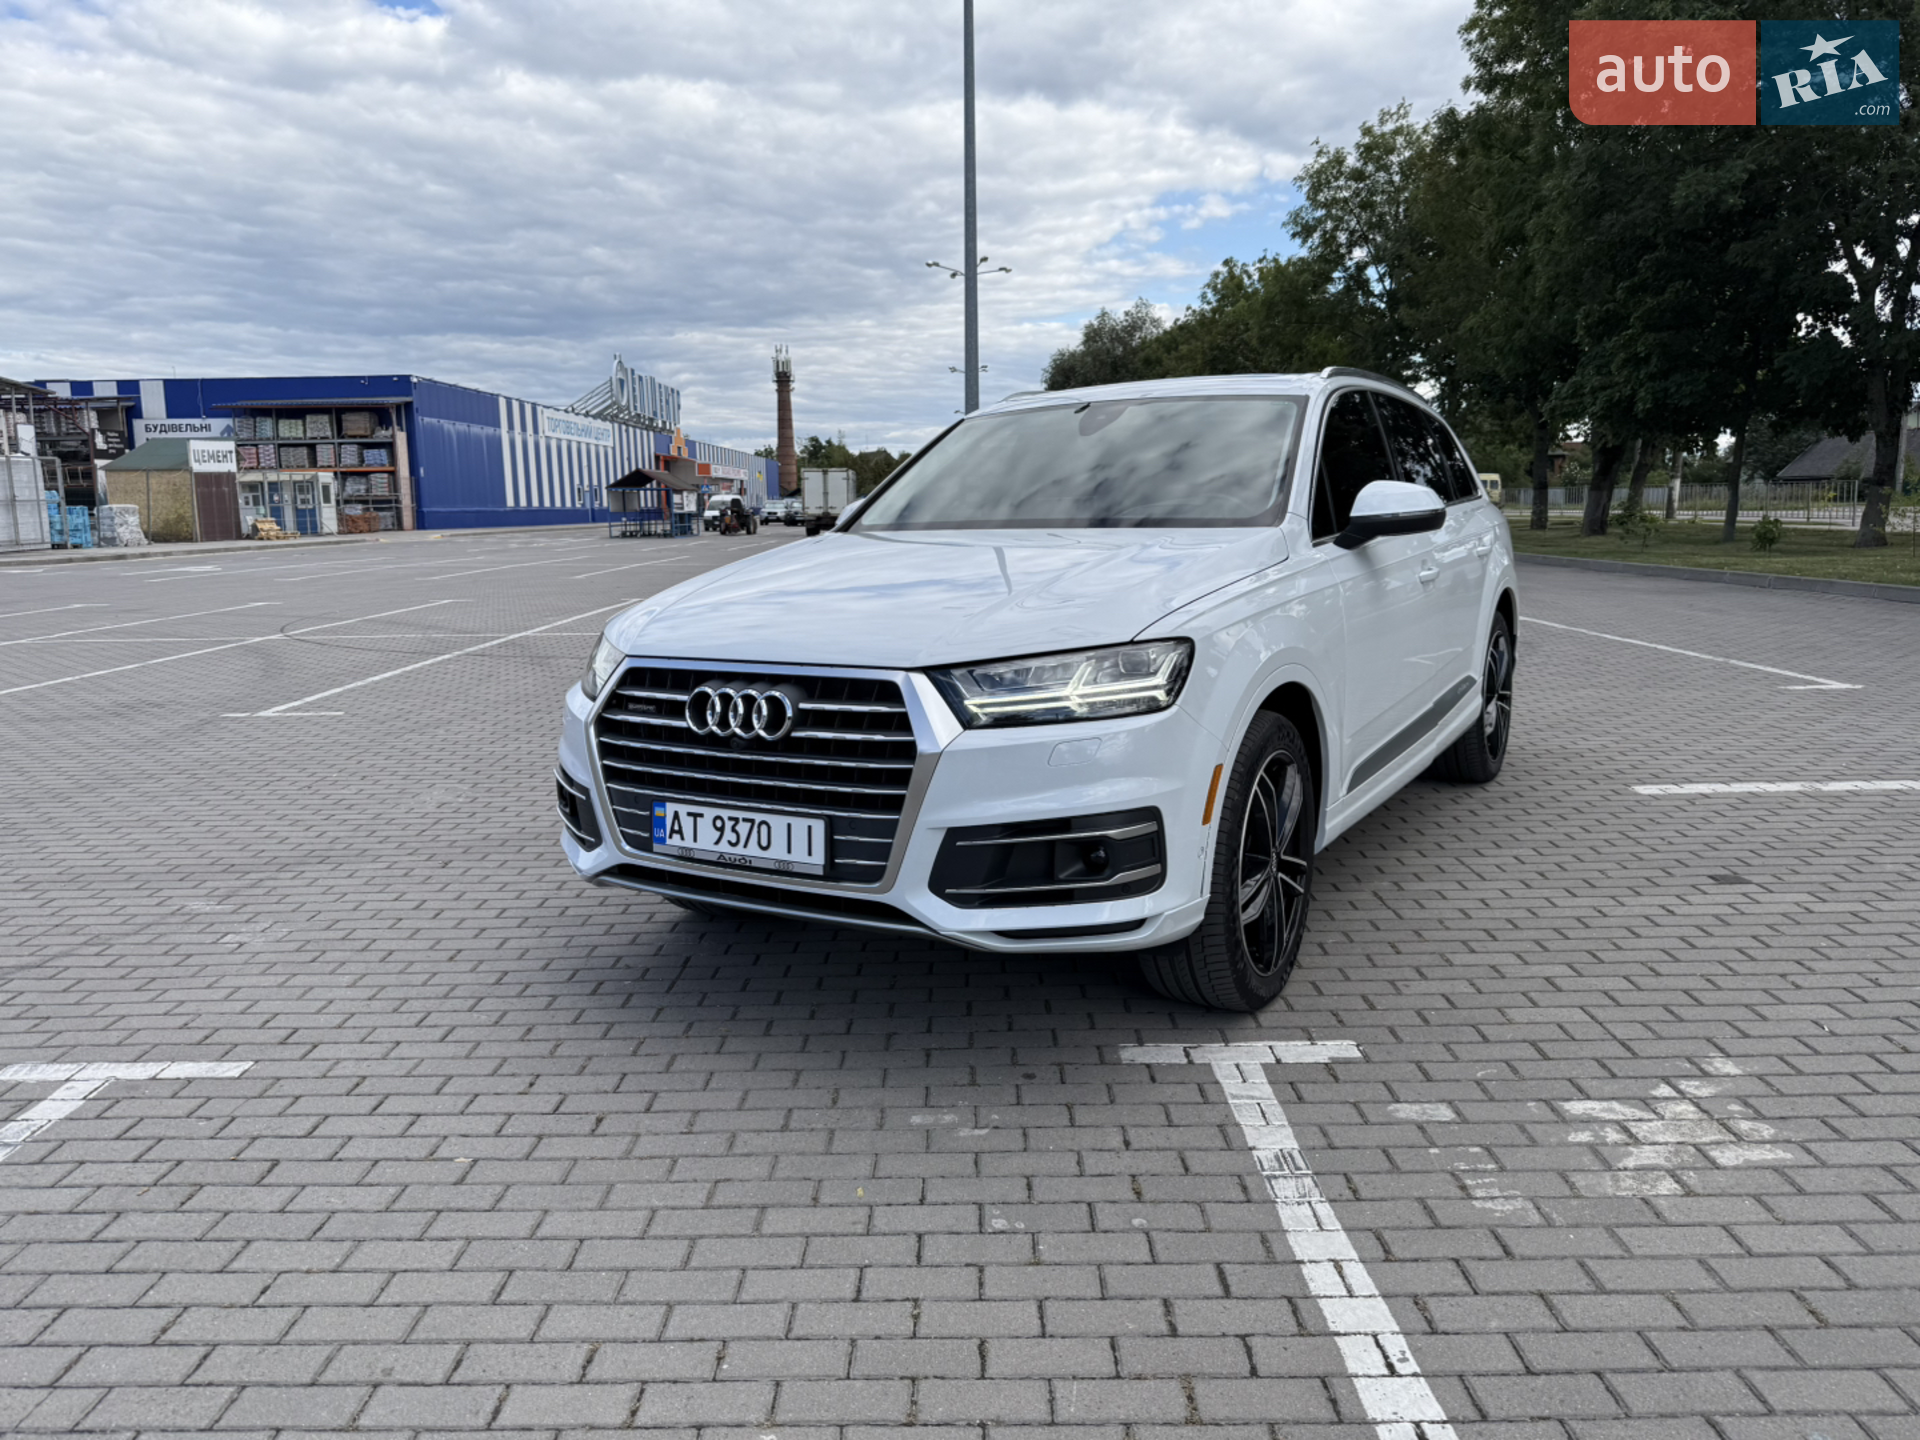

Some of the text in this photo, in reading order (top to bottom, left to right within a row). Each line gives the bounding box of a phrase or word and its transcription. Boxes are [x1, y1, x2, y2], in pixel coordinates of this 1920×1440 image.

[144, 423, 212, 435] БУДІВЕЛЬНІ
[192, 448, 234, 466] ЦЕМЕНТ
[654, 828, 665, 838] UA
[668, 810, 812, 857] AT 9370 II
[716, 853, 752, 865] Audi
